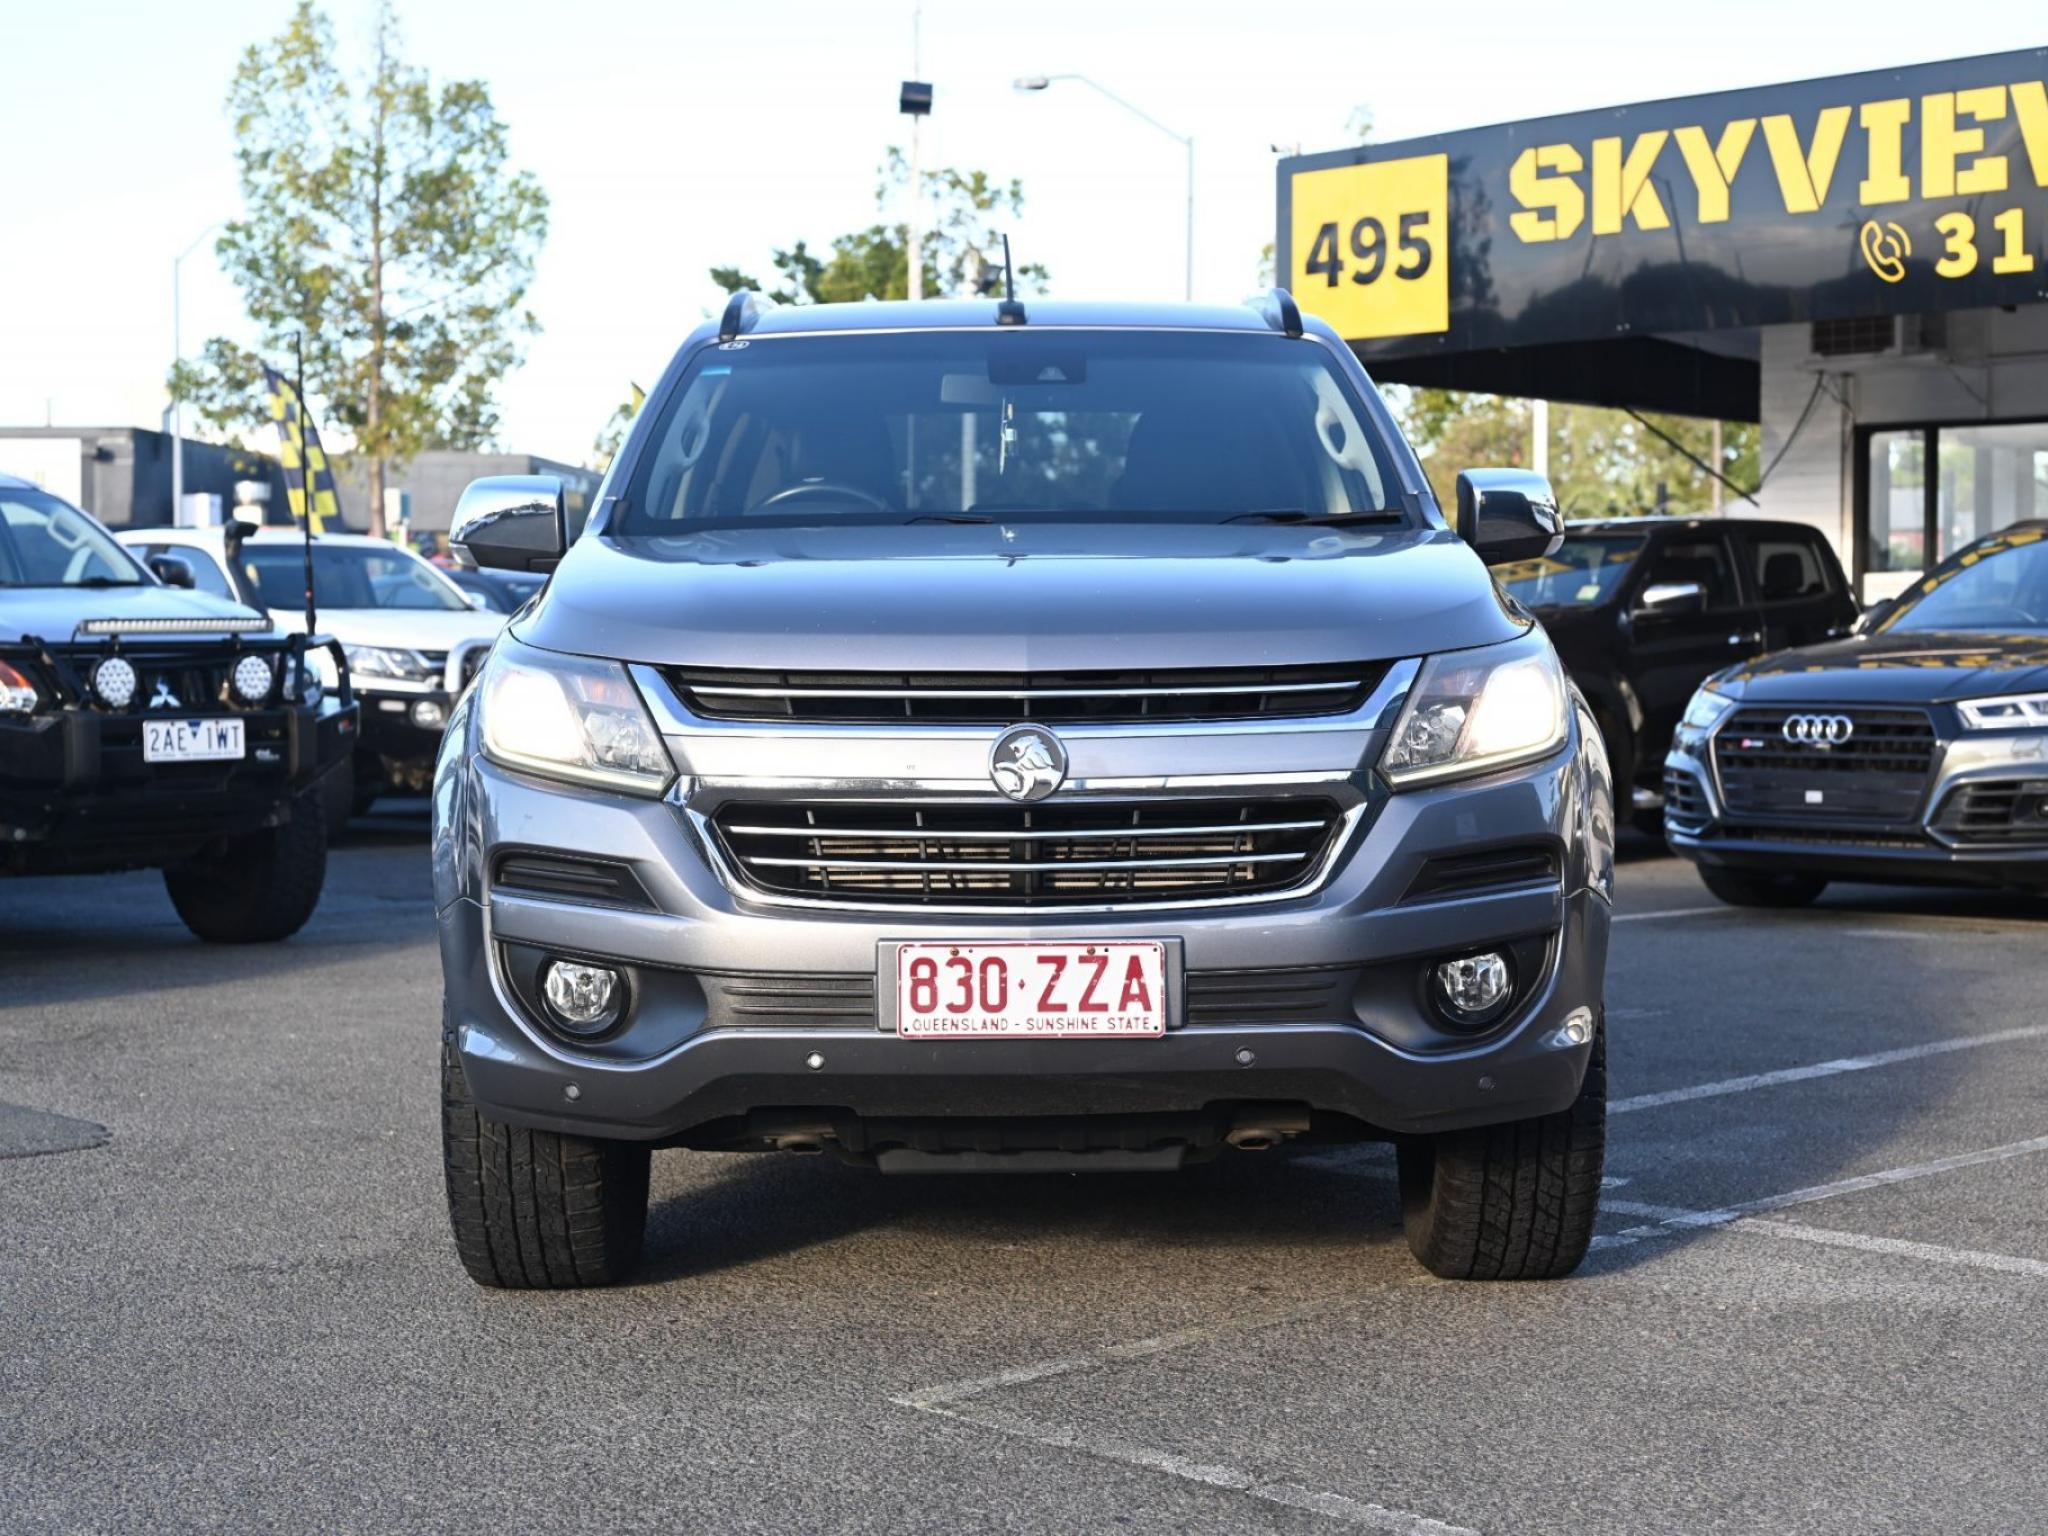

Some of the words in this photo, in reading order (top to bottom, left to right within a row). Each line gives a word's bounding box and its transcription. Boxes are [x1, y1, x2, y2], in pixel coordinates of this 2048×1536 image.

[1305, 210, 1433, 288] 495
[1933, 207, 2035, 279] 31
[150, 727, 188, 752] 2AE
[207, 726, 240, 750] 1WT
[912, 1017, 1009, 1032] QUEENSLAND
[1026, 1017, 1098, 1031] SUNSHINE
[1107, 1017, 1150, 1031] STATE
